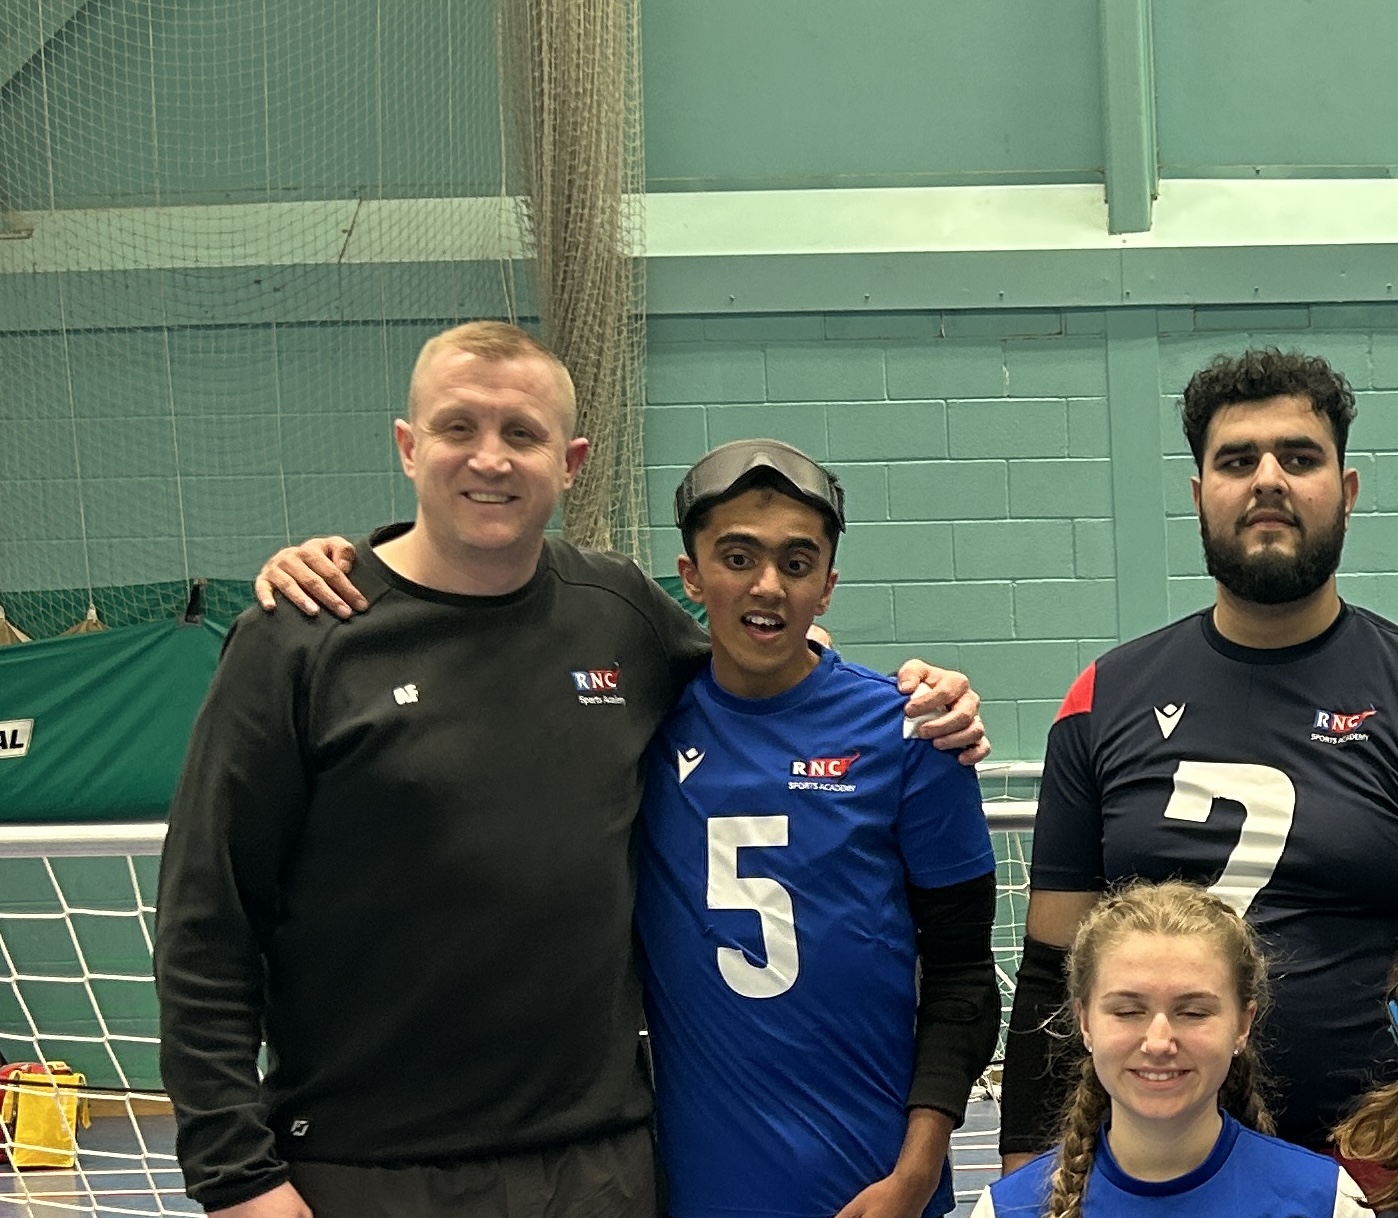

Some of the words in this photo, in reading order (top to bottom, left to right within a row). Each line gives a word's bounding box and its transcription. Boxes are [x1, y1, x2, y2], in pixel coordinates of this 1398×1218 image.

[573, 671, 617, 690] RNC
[1317, 711, 1360, 731] RNC
[0, 729, 24, 750] AL
[1310, 733, 1338, 745] SPORTS
[793, 760, 842, 777] RNC
[787, 781, 819, 791] SPORTS
[1164, 760, 1296, 918] 7
[705, 815, 800, 999] 5
